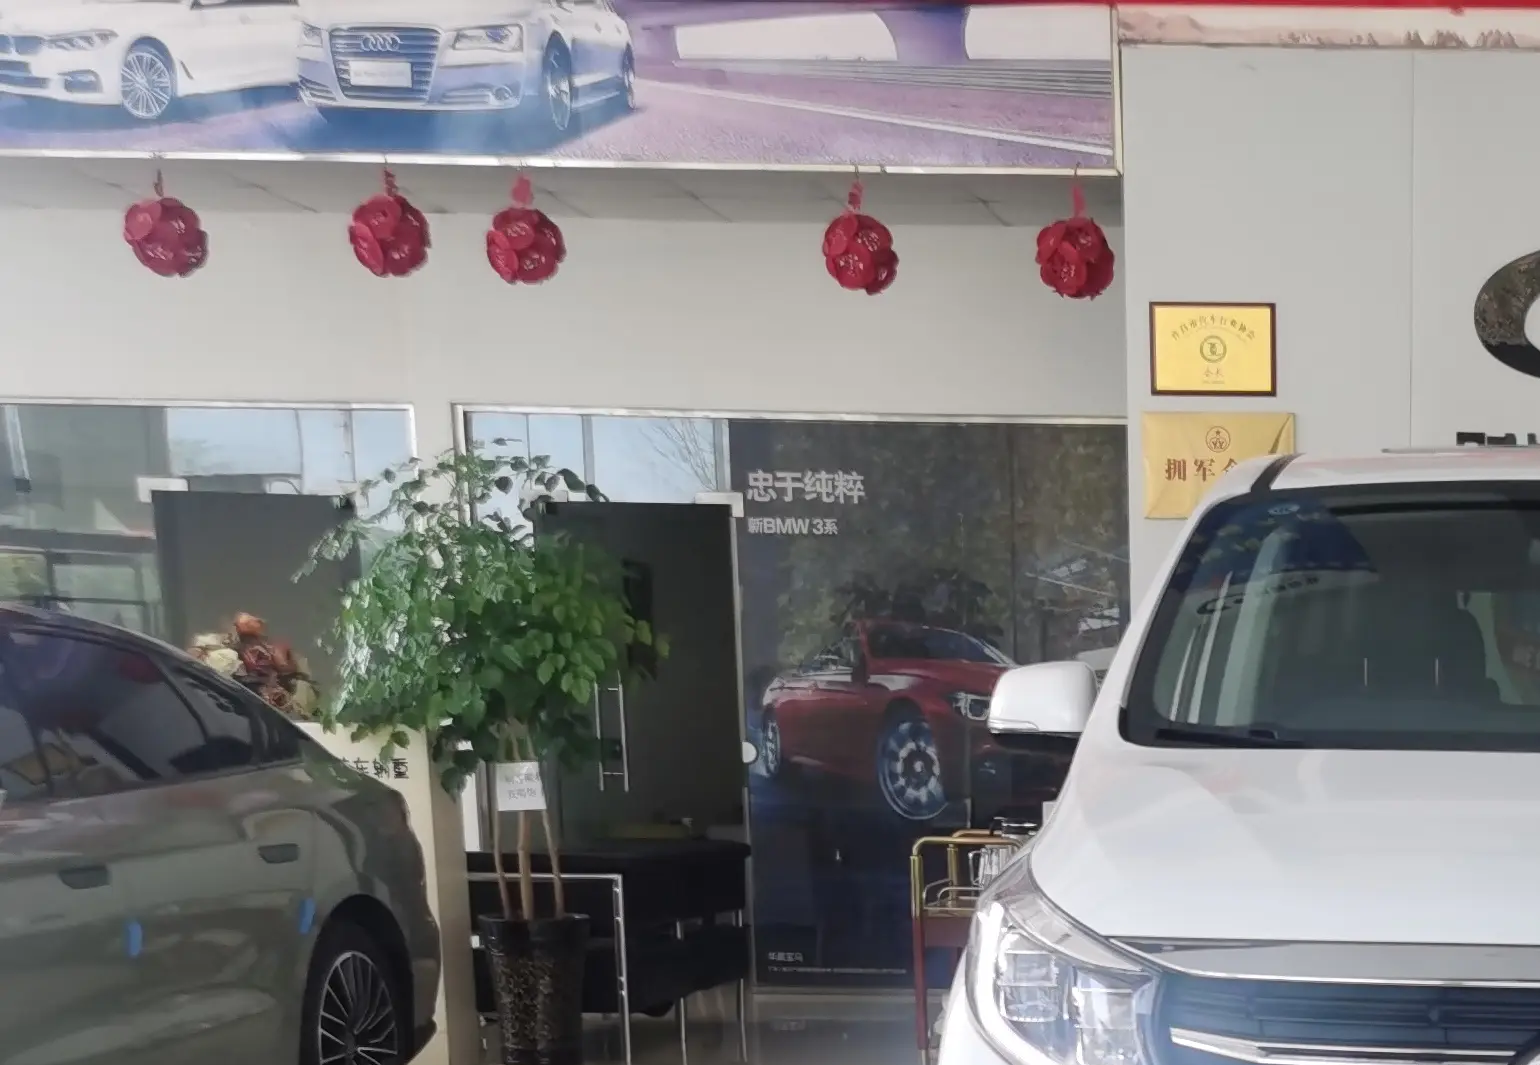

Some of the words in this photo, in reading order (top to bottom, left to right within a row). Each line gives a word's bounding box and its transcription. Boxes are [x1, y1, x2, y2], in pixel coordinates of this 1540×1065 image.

[747, 468, 867, 505] 忠于纯粹
[747, 517, 810, 535] 新BMW
[812, 518, 838, 535] 3系
